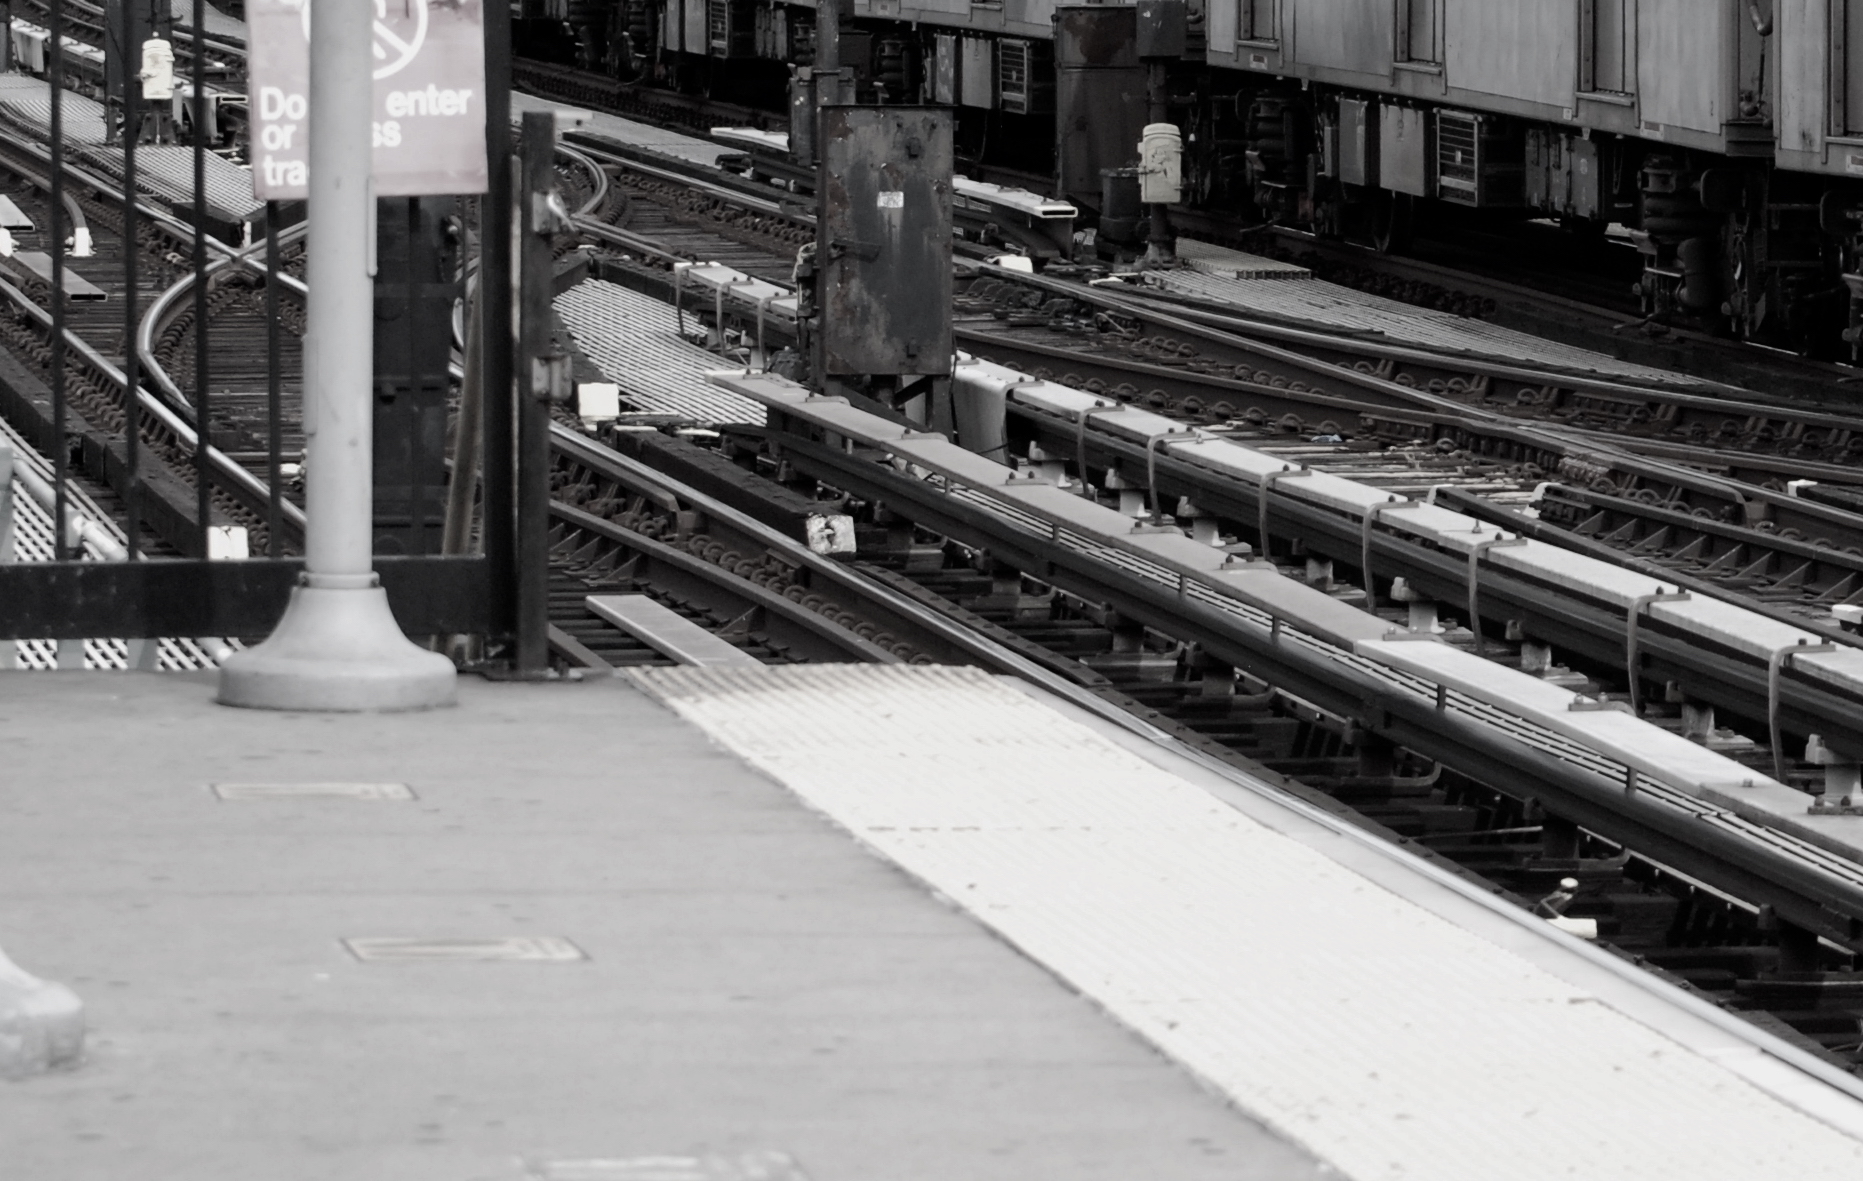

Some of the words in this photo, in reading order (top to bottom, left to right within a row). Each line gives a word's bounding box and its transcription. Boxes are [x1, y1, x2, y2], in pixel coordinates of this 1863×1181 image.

[260, 86, 307, 121] Do
[386, 83, 473, 117] enter
[261, 123, 297, 151] or
[263, 154, 309, 186] tra
